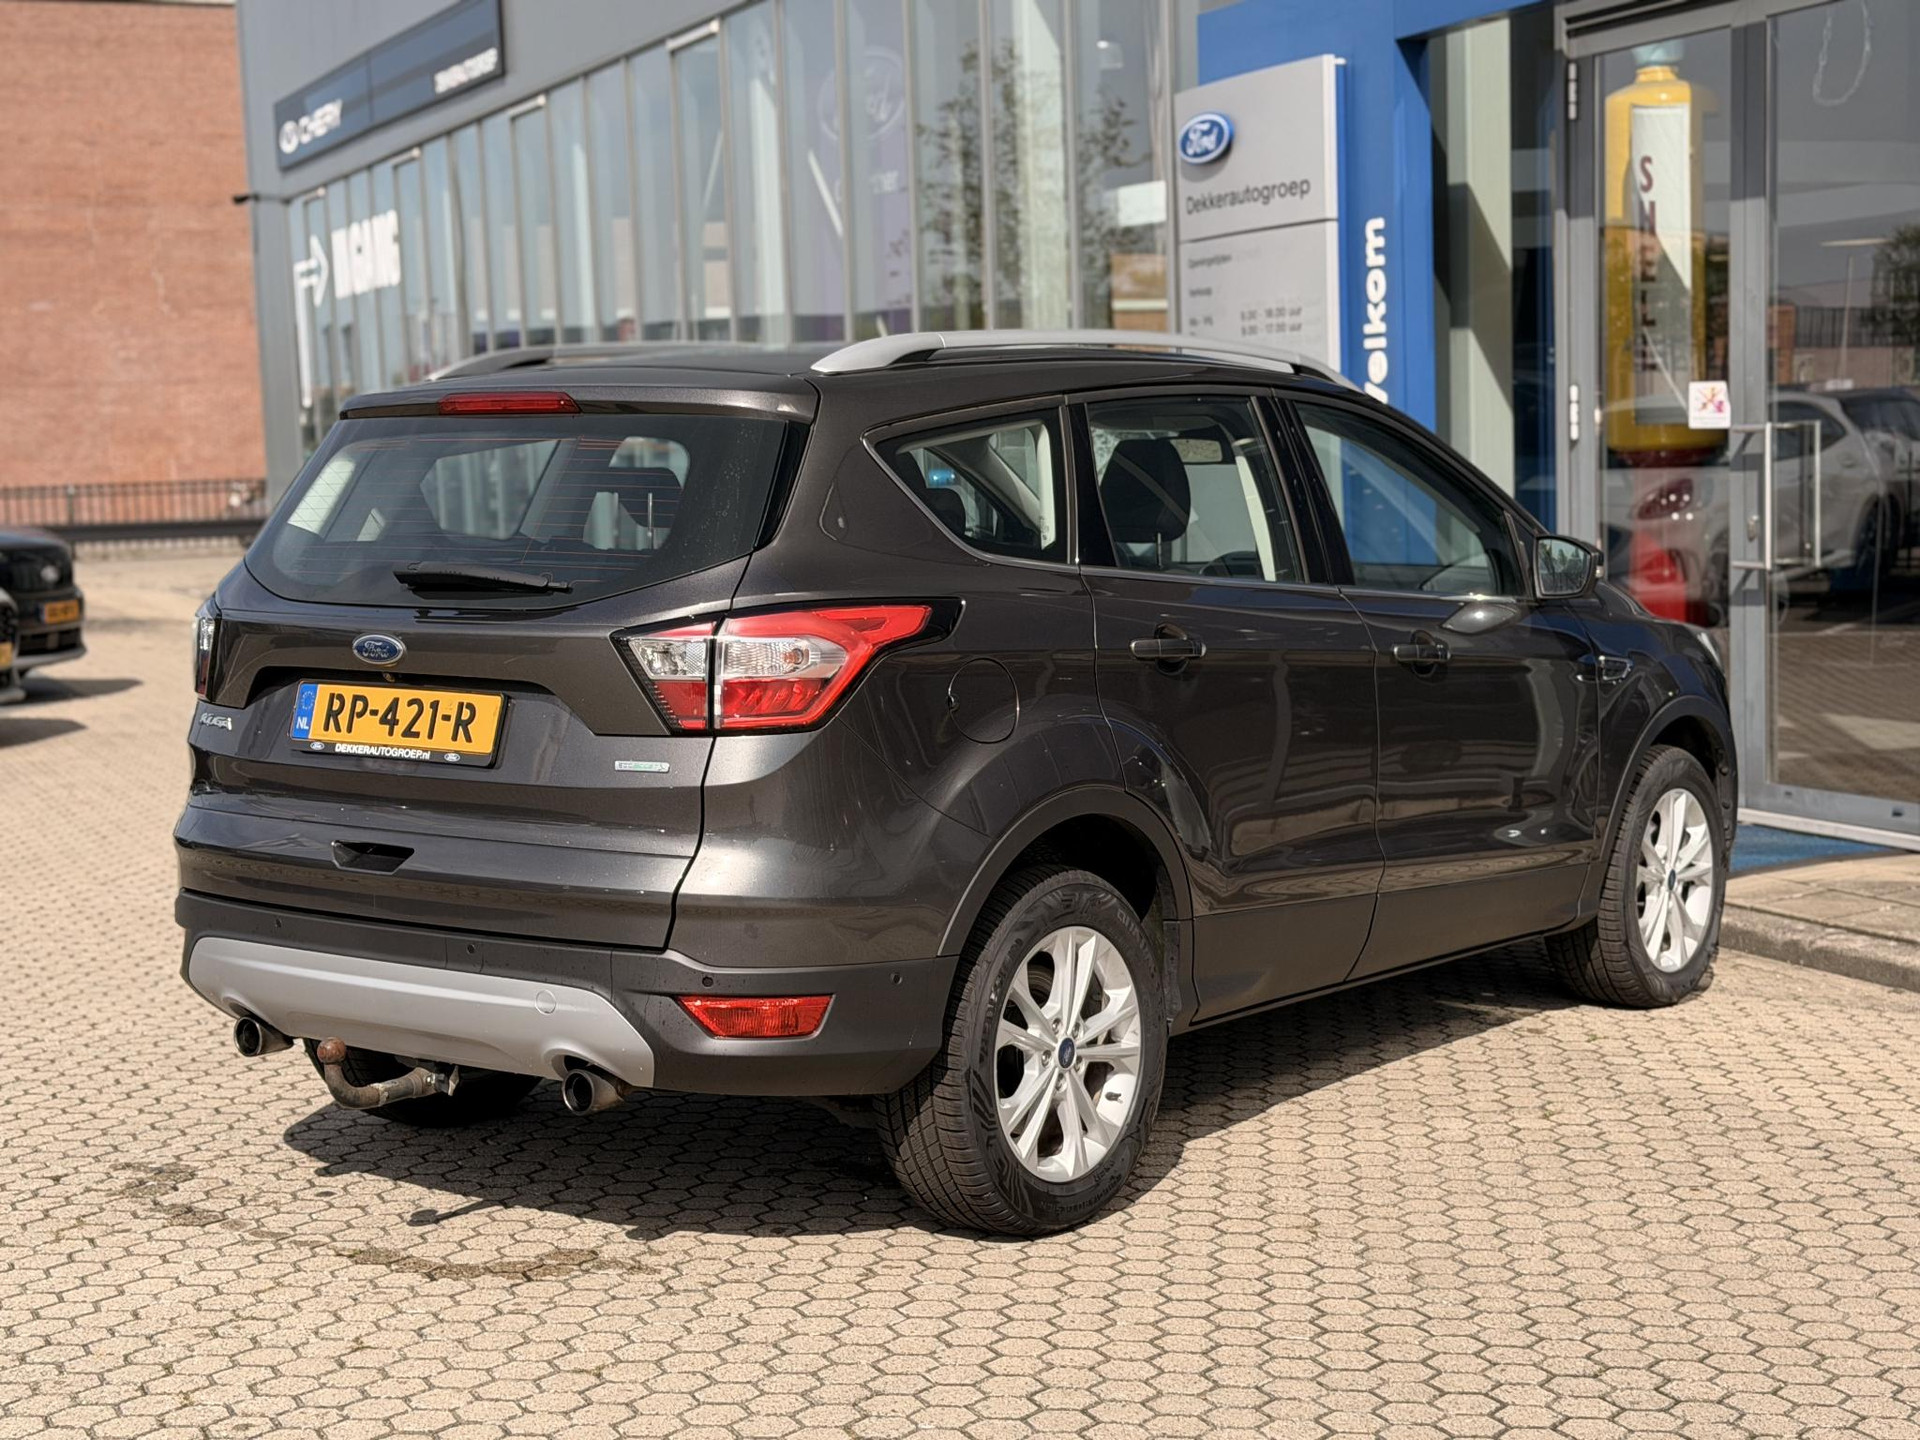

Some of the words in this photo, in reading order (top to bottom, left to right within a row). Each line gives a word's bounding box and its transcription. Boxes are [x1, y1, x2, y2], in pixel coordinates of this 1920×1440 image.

[1186, 179, 1311, 216] Dekkerautogroep
[296, 716, 310, 730] NL
[322, 692, 477, 744] RP-421-R
[334, 742, 431, 760] DEKKERAUTOGROEP.nl
